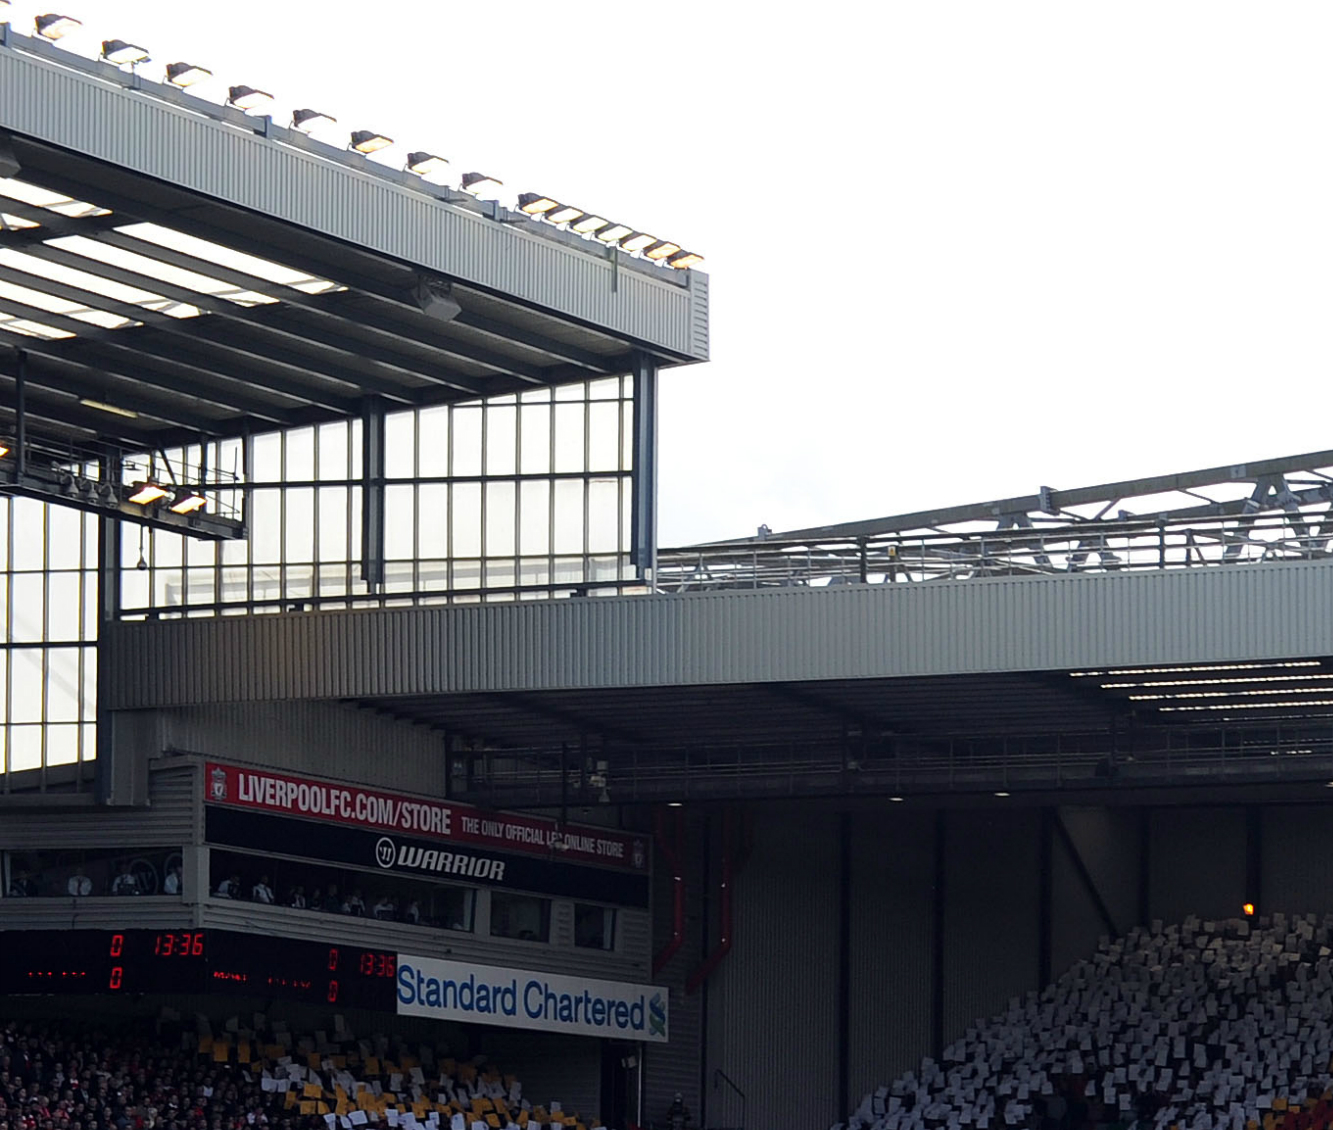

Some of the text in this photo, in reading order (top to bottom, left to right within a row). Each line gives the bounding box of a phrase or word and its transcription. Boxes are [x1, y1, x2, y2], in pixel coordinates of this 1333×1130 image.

[239, 774, 451, 834] LIVERPOOLFC.COM/STORE
[461, 816, 480, 834] THE
[481, 820, 505, 838] ONLY
[505, 825, 545, 846] OFFICIAL
[564, 834, 596, 853] ONLINE
[597, 839, 624, 858] STORE
[398, 845, 506, 881] WARRIOR
[110, 935, 123, 957] 0
[155, 934, 203, 956] 13:36
[329, 949, 338, 971] 0
[360, 953, 395, 977] 13:36
[110, 967, 123, 989] 0
[328, 980, 338, 1002] 0
[397, 965, 645, 1030] Standard Chartered
